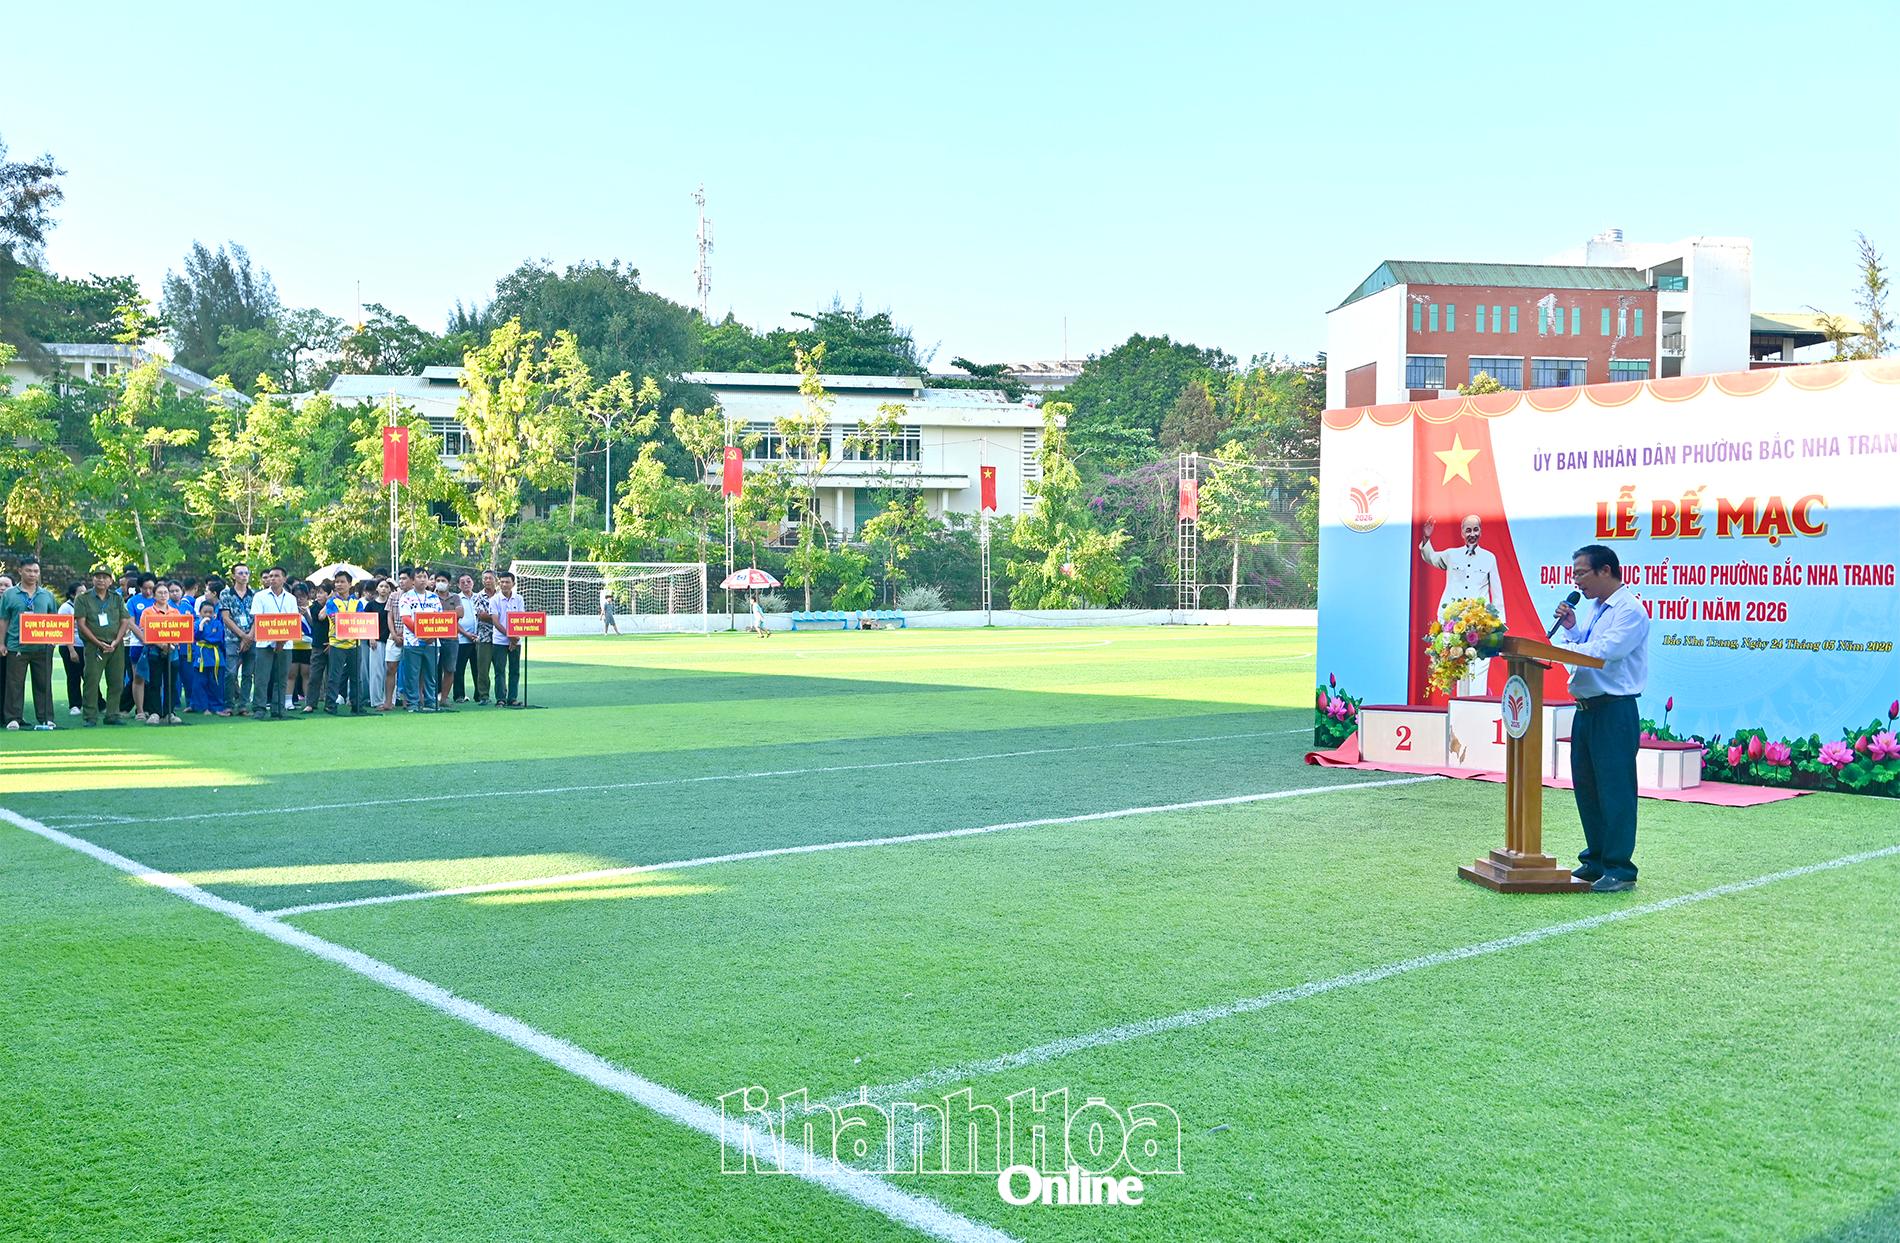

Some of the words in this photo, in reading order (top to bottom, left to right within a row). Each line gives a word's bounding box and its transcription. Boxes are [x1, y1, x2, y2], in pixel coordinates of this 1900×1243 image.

[1533, 447, 1552, 472] ỦY
[1557, 451, 1588, 470] BAN
[1593, 444, 1637, 468] NHÂN
[1643, 442, 1676, 466] DÂN
[1682, 438, 1753, 464] PHƯỜNG
[1759, 432, 1795, 460] BẮC
[1802, 437, 1840, 458] NHA
[1848, 433, 1900, 455] TRAN
[1595, 485, 1641, 541] LỄ
[1650, 485, 1707, 540] BẾ
[1716, 494, 1828, 547] MẠC
[1541, 565, 1561, 589] ĐẠI
[1645, 557, 1669, 585] THỂ
[1673, 565, 1707, 586] THAO
[1711, 560, 1768, 586] PHƯỜNG
[1773, 556, 1803, 586] BẮC
[1807, 565, 1838, 586] NHA
[1844, 564, 1895, 586] TRANG
[1658, 596, 1689, 620] THỨ
[1692, 601, 1697, 620] I
[1702, 597, 1741, 621] NĂM
[1746, 602, 1787, 622] 2026
[1683, 635, 1705, 647] Nha
[1741, 636, 1769, 651] Ngày
[1785, 638, 1821, 652] Tháng
[1836, 640, 1864, 652] Năm
[1865, 641, 1893, 652] 2026
[1395, 725, 1412, 751] 2
